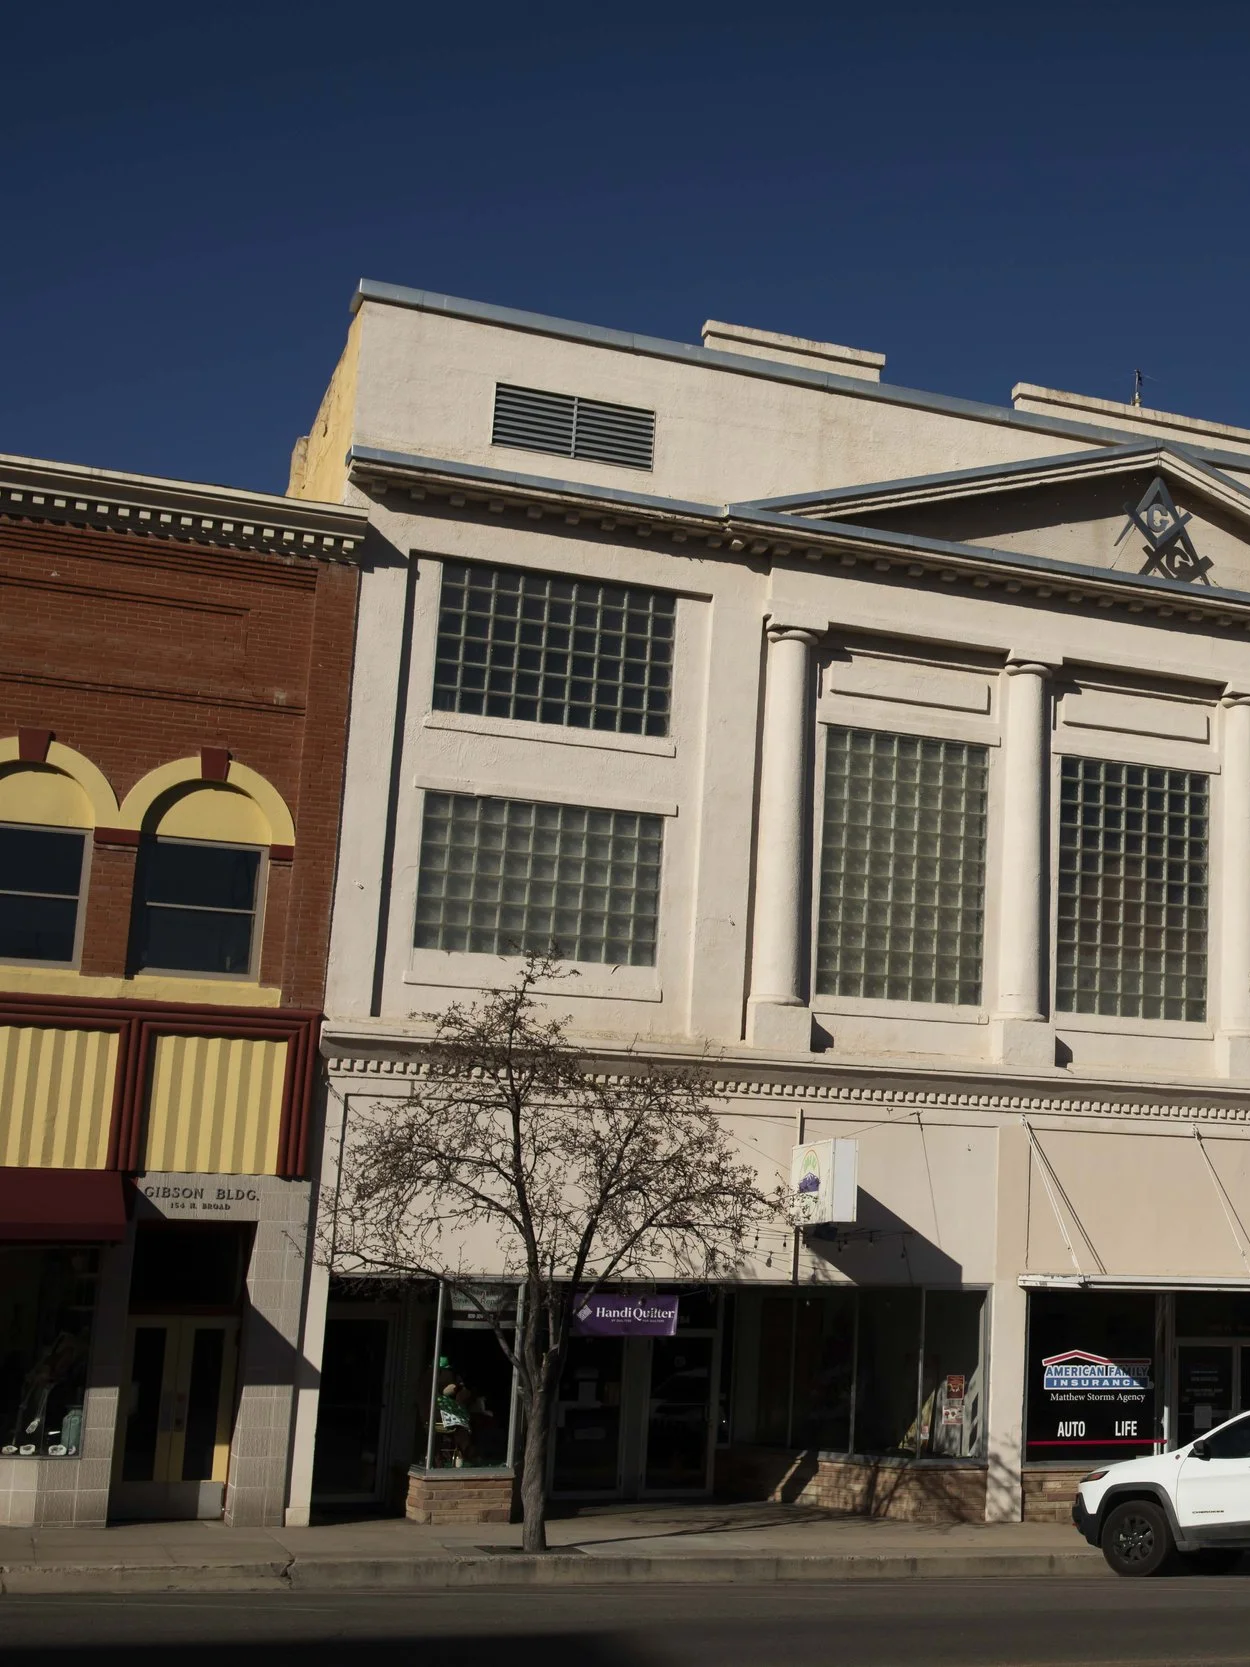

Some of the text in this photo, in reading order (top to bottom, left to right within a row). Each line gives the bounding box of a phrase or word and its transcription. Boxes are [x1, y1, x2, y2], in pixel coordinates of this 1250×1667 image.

[144, 1186, 260, 1201] GIBSON BLDG.
[202, 1203, 231, 1211] BROAD
[1045, 1366, 1149, 1377] AMERICAN FAMILY
[1053, 1379, 1141, 1387] INSURANCE
[1050, 1392, 1146, 1403] Matthew Storms Agency
[1057, 1421, 1086, 1438] AUTO
[1114, 1420, 1138, 1437] LIFE
